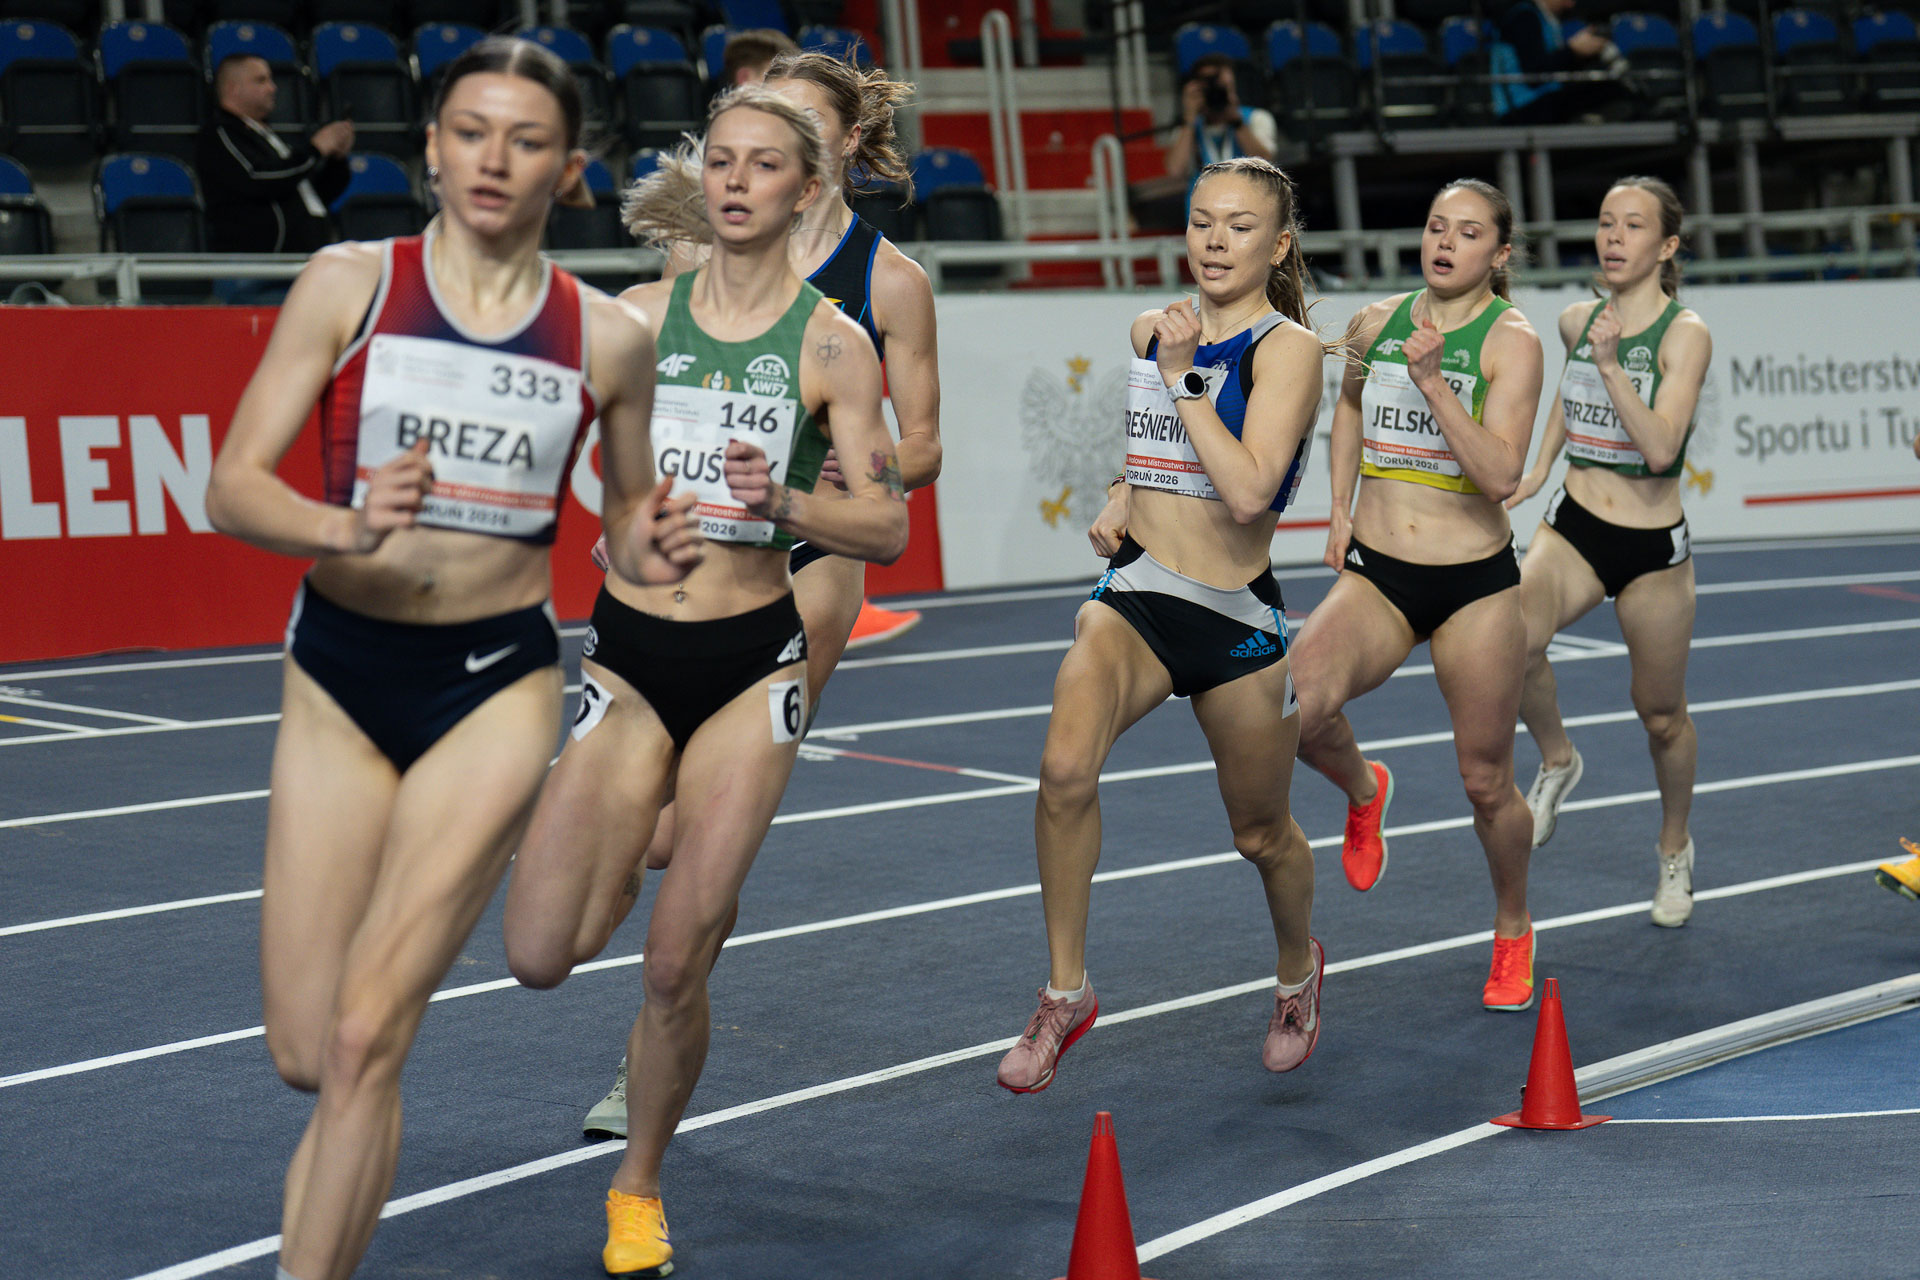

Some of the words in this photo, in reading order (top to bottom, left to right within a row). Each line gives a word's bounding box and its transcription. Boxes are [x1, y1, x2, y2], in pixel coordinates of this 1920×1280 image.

[1376, 338, 1404, 355] 4F
[656, 353, 697, 378] 4F
[756, 361, 782, 377] AZS
[490, 365, 562, 404] 333
[749, 378, 785, 396] AWF
[720, 402, 778, 433] 146
[396, 413, 534, 472] BREZA
[1734, 413, 1849, 463] Sportu
[1859, 408, 1870, 448] i
[1147, 459, 1185, 471] Mistrzostwa
[1379, 455, 1413, 467] TORUŃ
[1416, 460, 1439, 471] 2026
[0, 414, 217, 540] LEN
[1126, 469, 1152, 482] TORUŃ
[1154, 473, 1179, 485] 2026
[702, 521, 737, 536] 2026
[777, 630, 803, 663] 4F
[1230, 643, 1277, 658] adidas
[783, 685, 800, 736] 6
